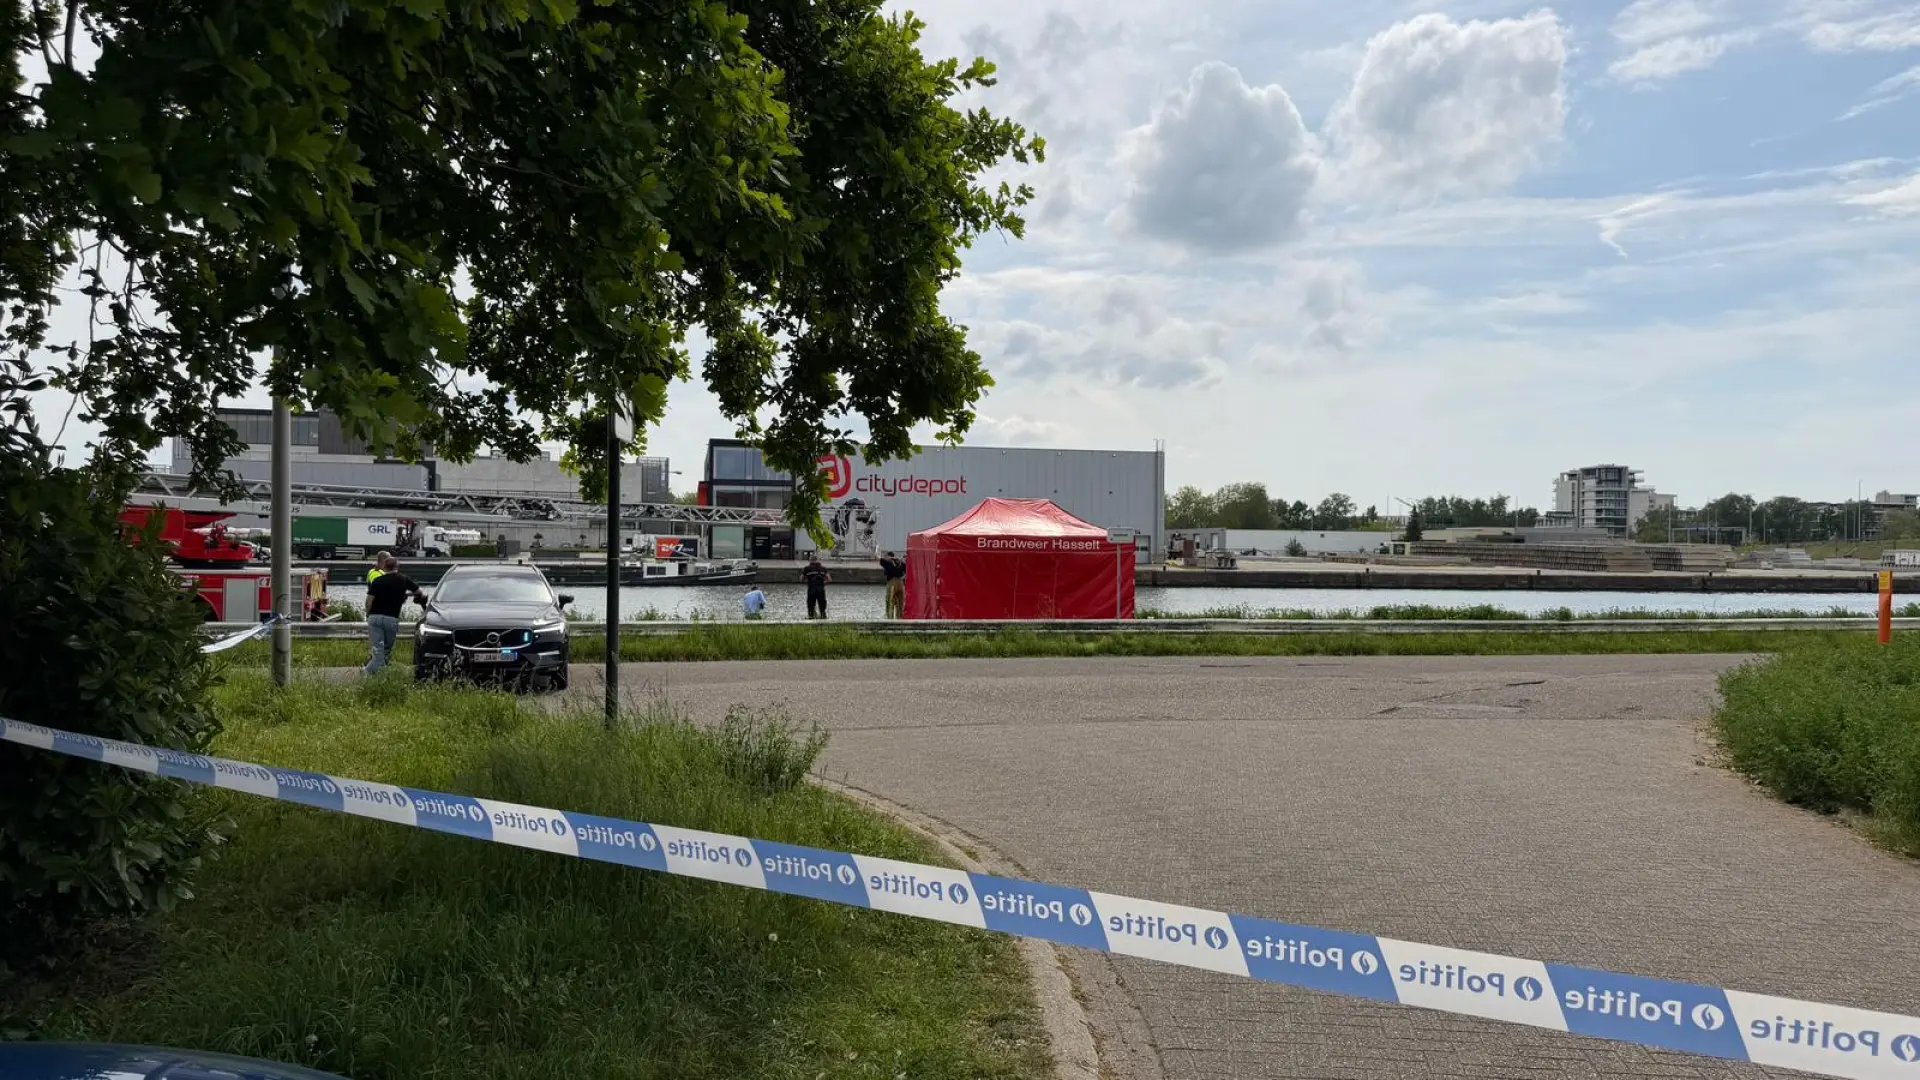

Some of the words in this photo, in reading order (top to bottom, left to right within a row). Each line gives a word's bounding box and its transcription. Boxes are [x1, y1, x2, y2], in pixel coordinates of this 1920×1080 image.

[856, 474, 966, 497] citydepot
[368, 524, 391, 534] GRL
[977, 537, 1048, 549] Brandweer
[1052, 539, 1100, 551] Hasselt
